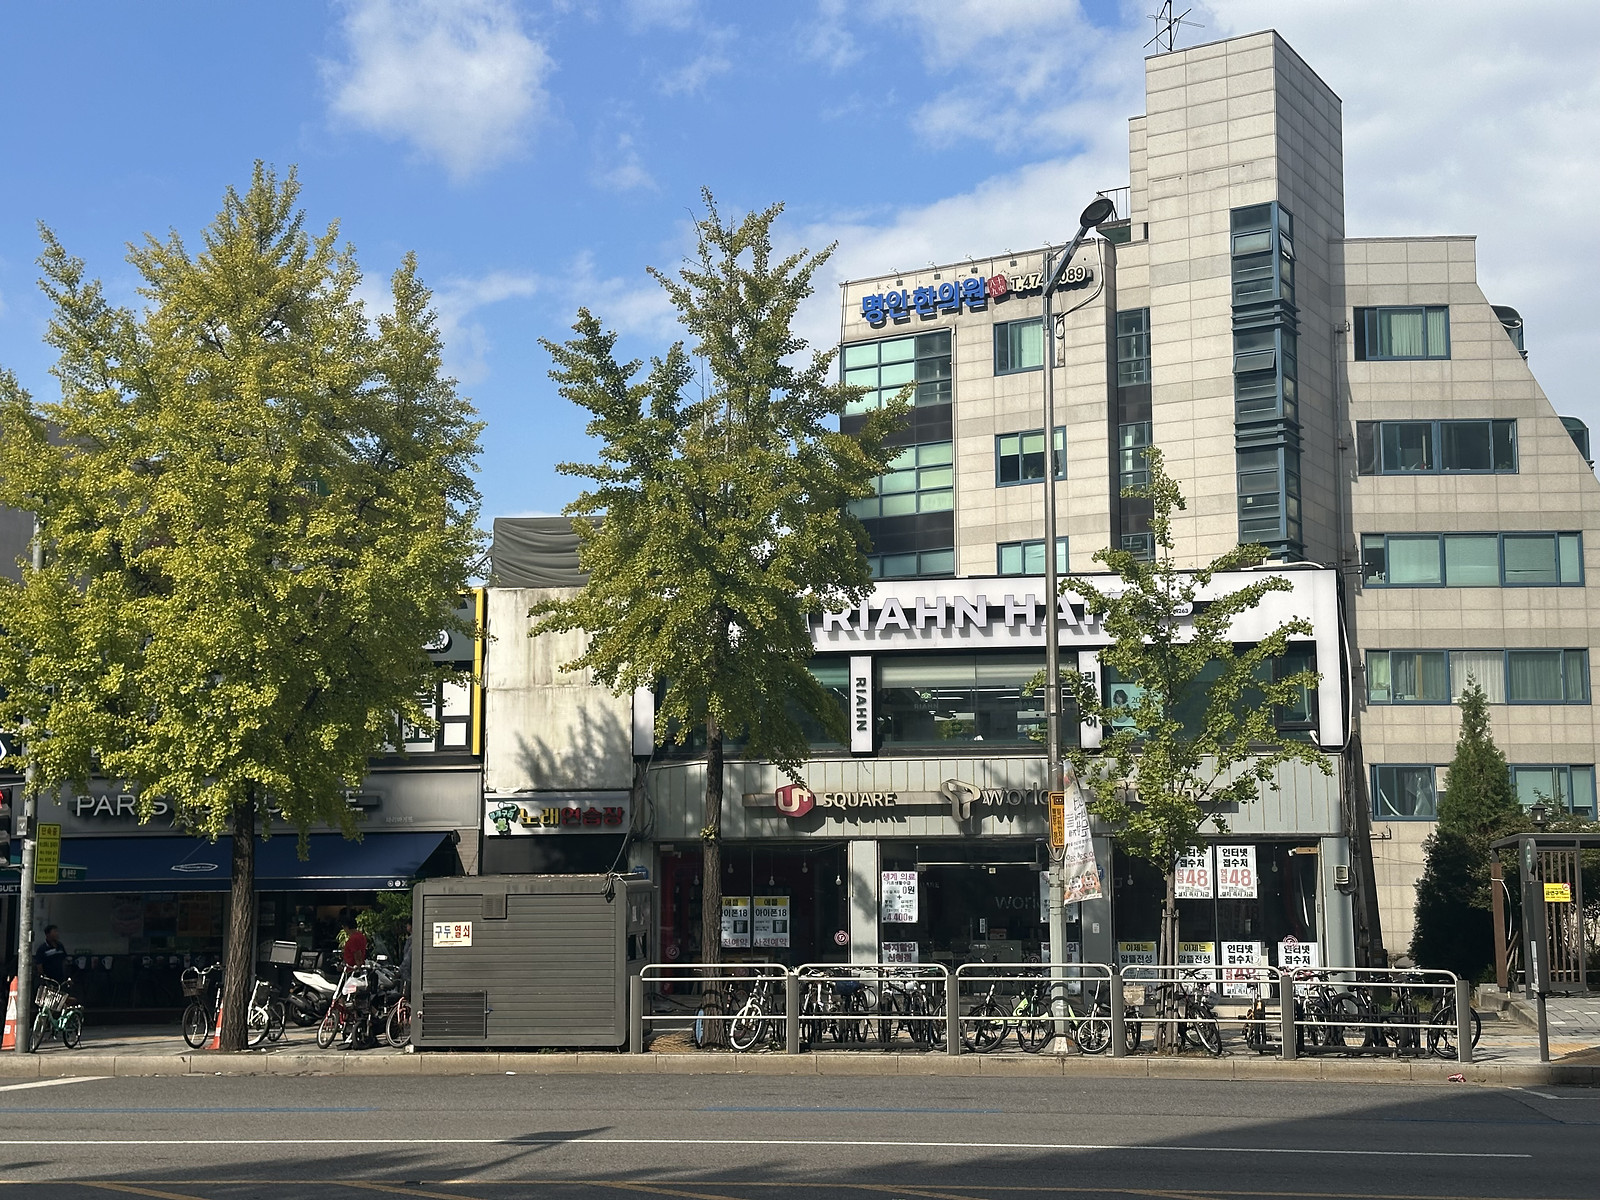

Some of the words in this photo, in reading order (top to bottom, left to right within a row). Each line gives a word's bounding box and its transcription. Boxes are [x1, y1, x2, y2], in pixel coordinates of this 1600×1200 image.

[1011, 266, 1085, 290] T.474089
[823, 594, 986, 631] RIAHN
[856, 677, 867, 731] RIAHN
[1082, 671, 1096, 728] 리어
[76, 795, 168, 817] PARS
[823, 792, 896, 808] SQUARE
[520, 806, 624, 826] 노래연습장
[1222, 848, 1248, 857] 인터넷
[900, 873, 915, 881] 의료
[1186, 869, 1208, 887] 48
[1230, 869, 1252, 887] 48
[994, 892, 1037, 909] worl
[721, 909, 747, 917] 이폰18
[755, 909, 786, 917] 아이폰18
[721, 938, 748, 946] 전예약
[755, 938, 787, 946] 사전예약
[1227, 945, 1252, 953] 인터넷
